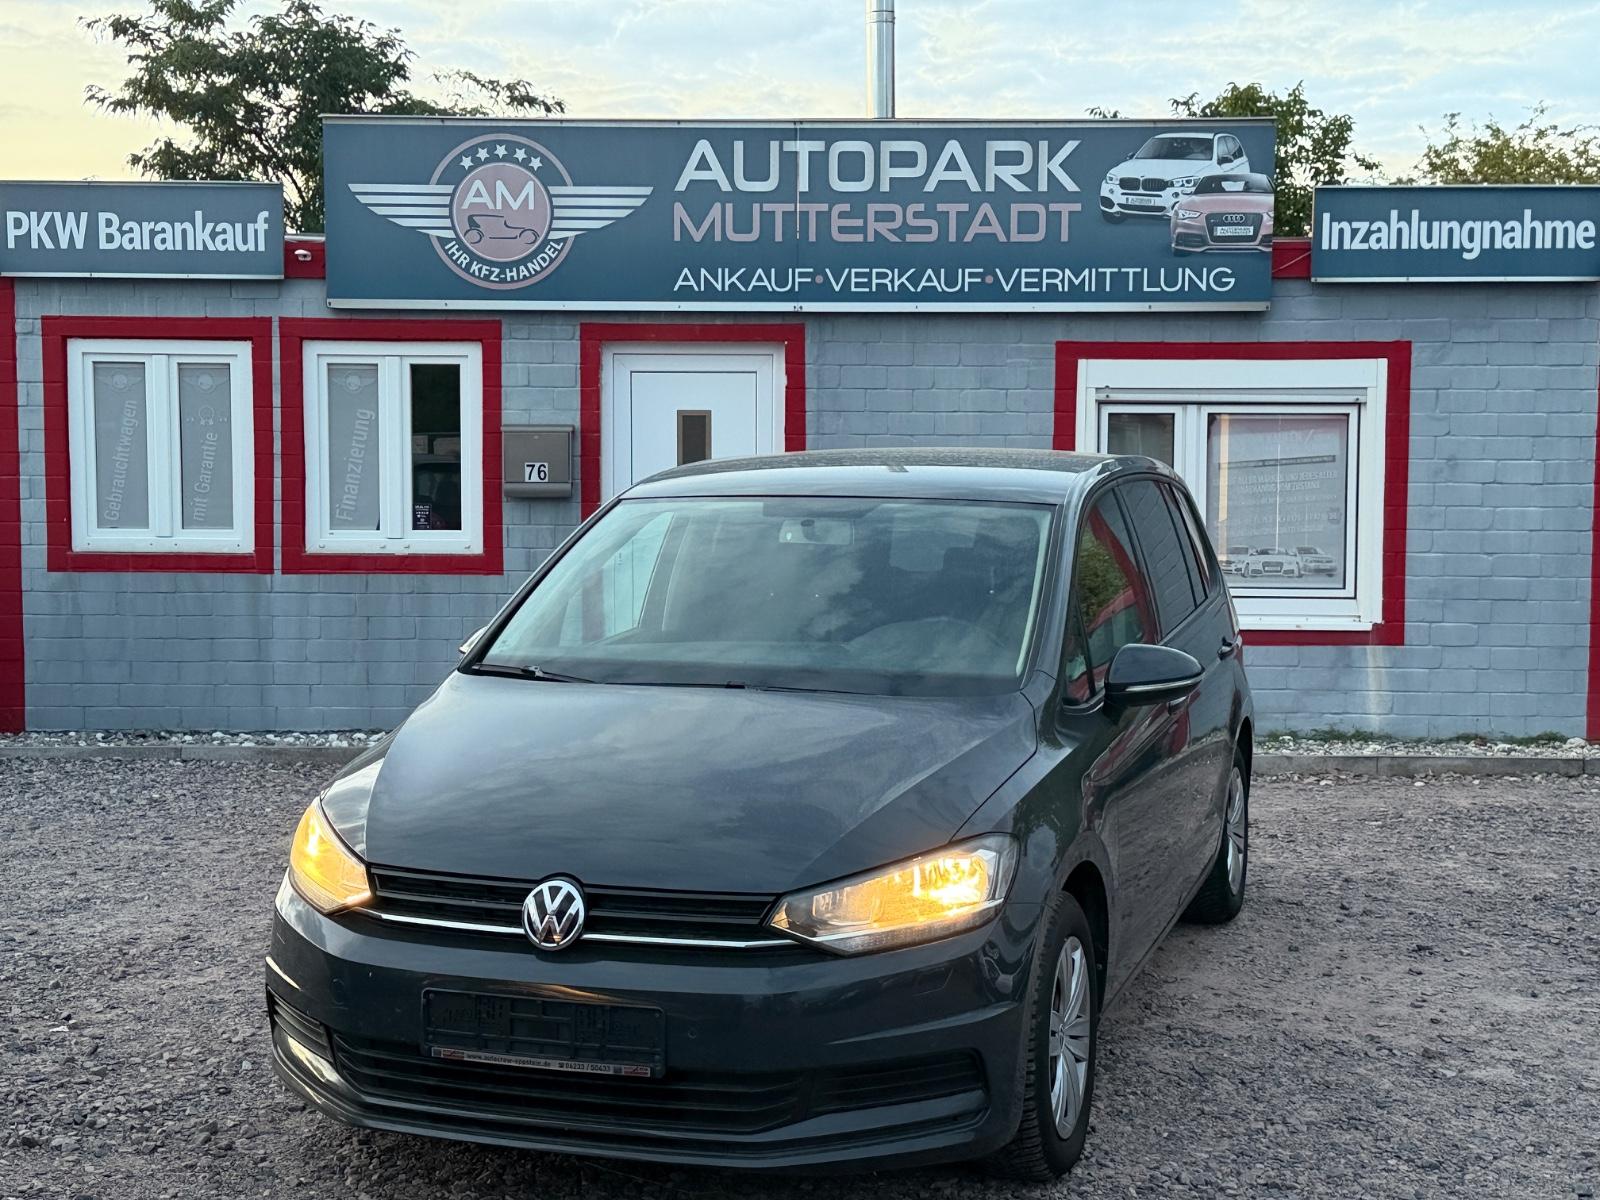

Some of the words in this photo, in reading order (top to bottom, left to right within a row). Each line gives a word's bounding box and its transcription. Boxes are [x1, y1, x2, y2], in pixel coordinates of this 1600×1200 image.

[673, 139, 1082, 192] AUTOPARK
[461, 179, 535, 211] AM
[6, 211, 88, 249] PKW
[98, 210, 269, 252] Barankauf
[673, 202, 1082, 243] MUTTERSTADT
[1321, 209, 1596, 260] Inzahlungnahme
[444, 240, 470, 269] IHR
[470, 241, 564, 282] KFZ-HANDEL
[673, 267, 814, 293] ANKAUF
[825, 267, 985, 293] VERKAUF
[995, 267, 1236, 293] VERMITTLUNG
[104, 400, 138, 521] Gebrauchtwagen
[194, 431, 218, 494] Garantie
[335, 408, 376, 521] Finanzierung
[526, 464, 547, 481] 76
[190, 499, 208, 521] mit
